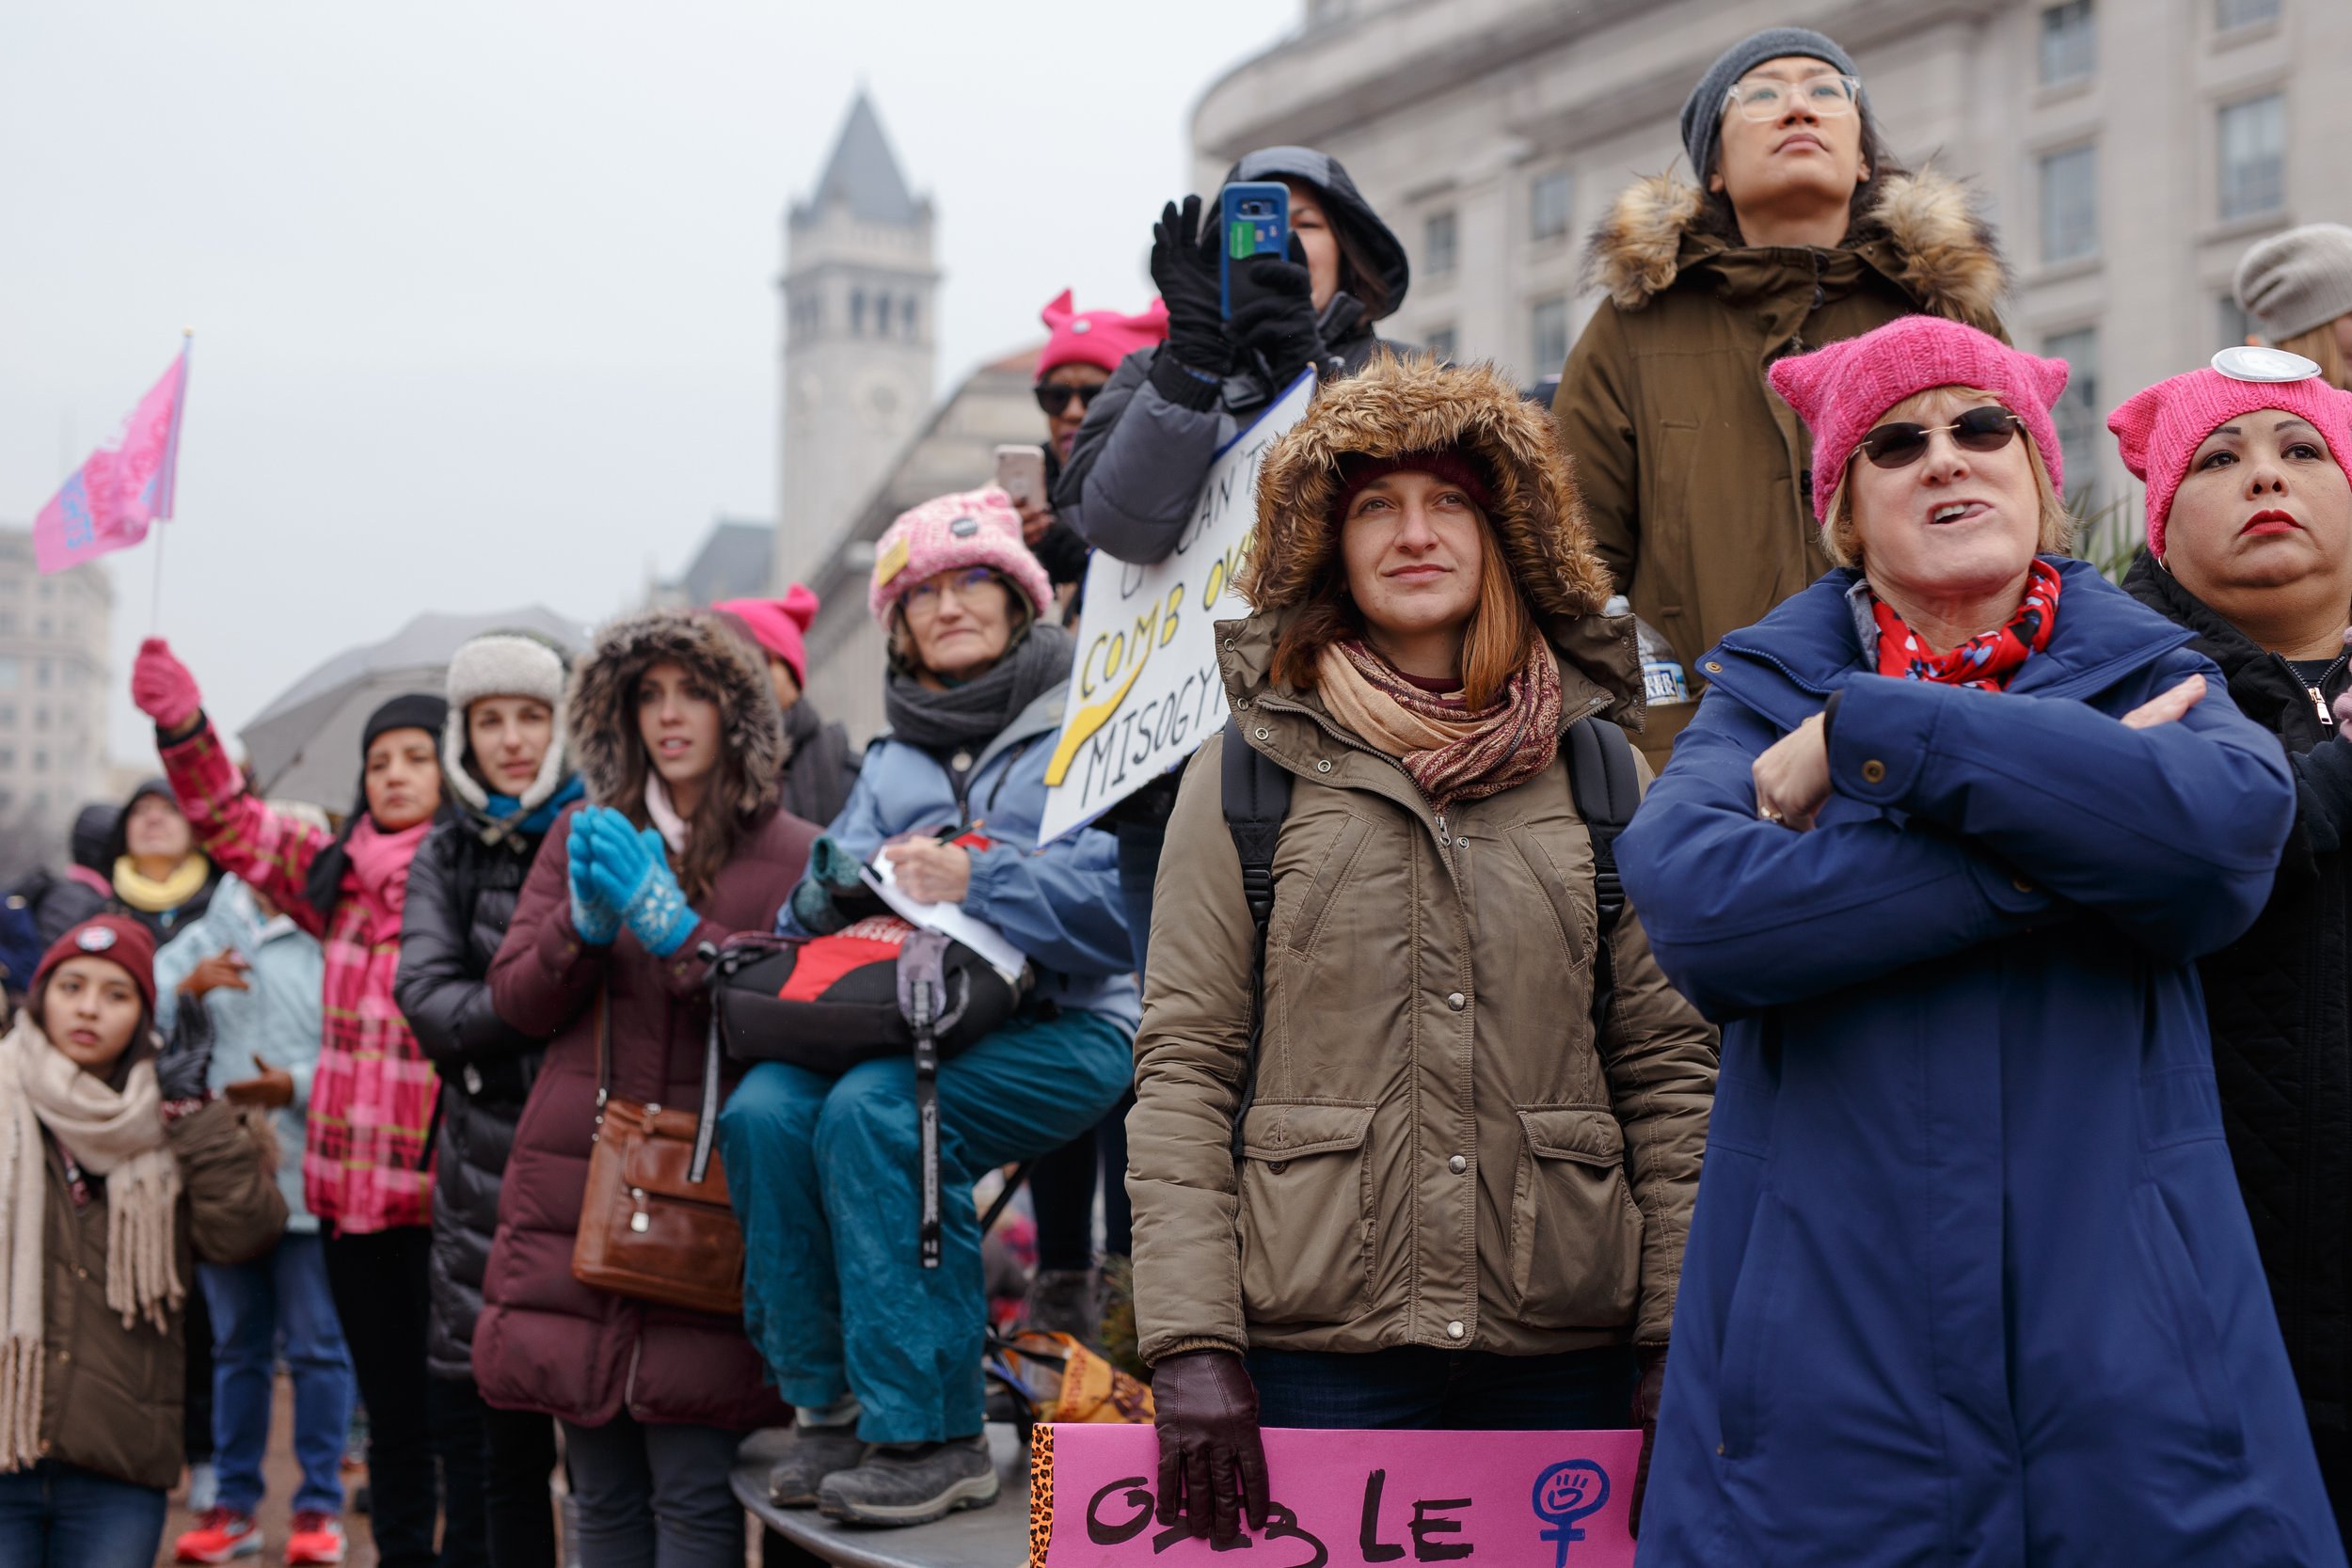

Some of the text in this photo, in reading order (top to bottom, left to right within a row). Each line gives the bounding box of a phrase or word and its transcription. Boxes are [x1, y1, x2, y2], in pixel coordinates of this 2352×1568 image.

[1081, 523, 1257, 701] COMB OV
[1080, 659, 1224, 809] MISOGY
[1645, 683, 1677, 698] ARK
